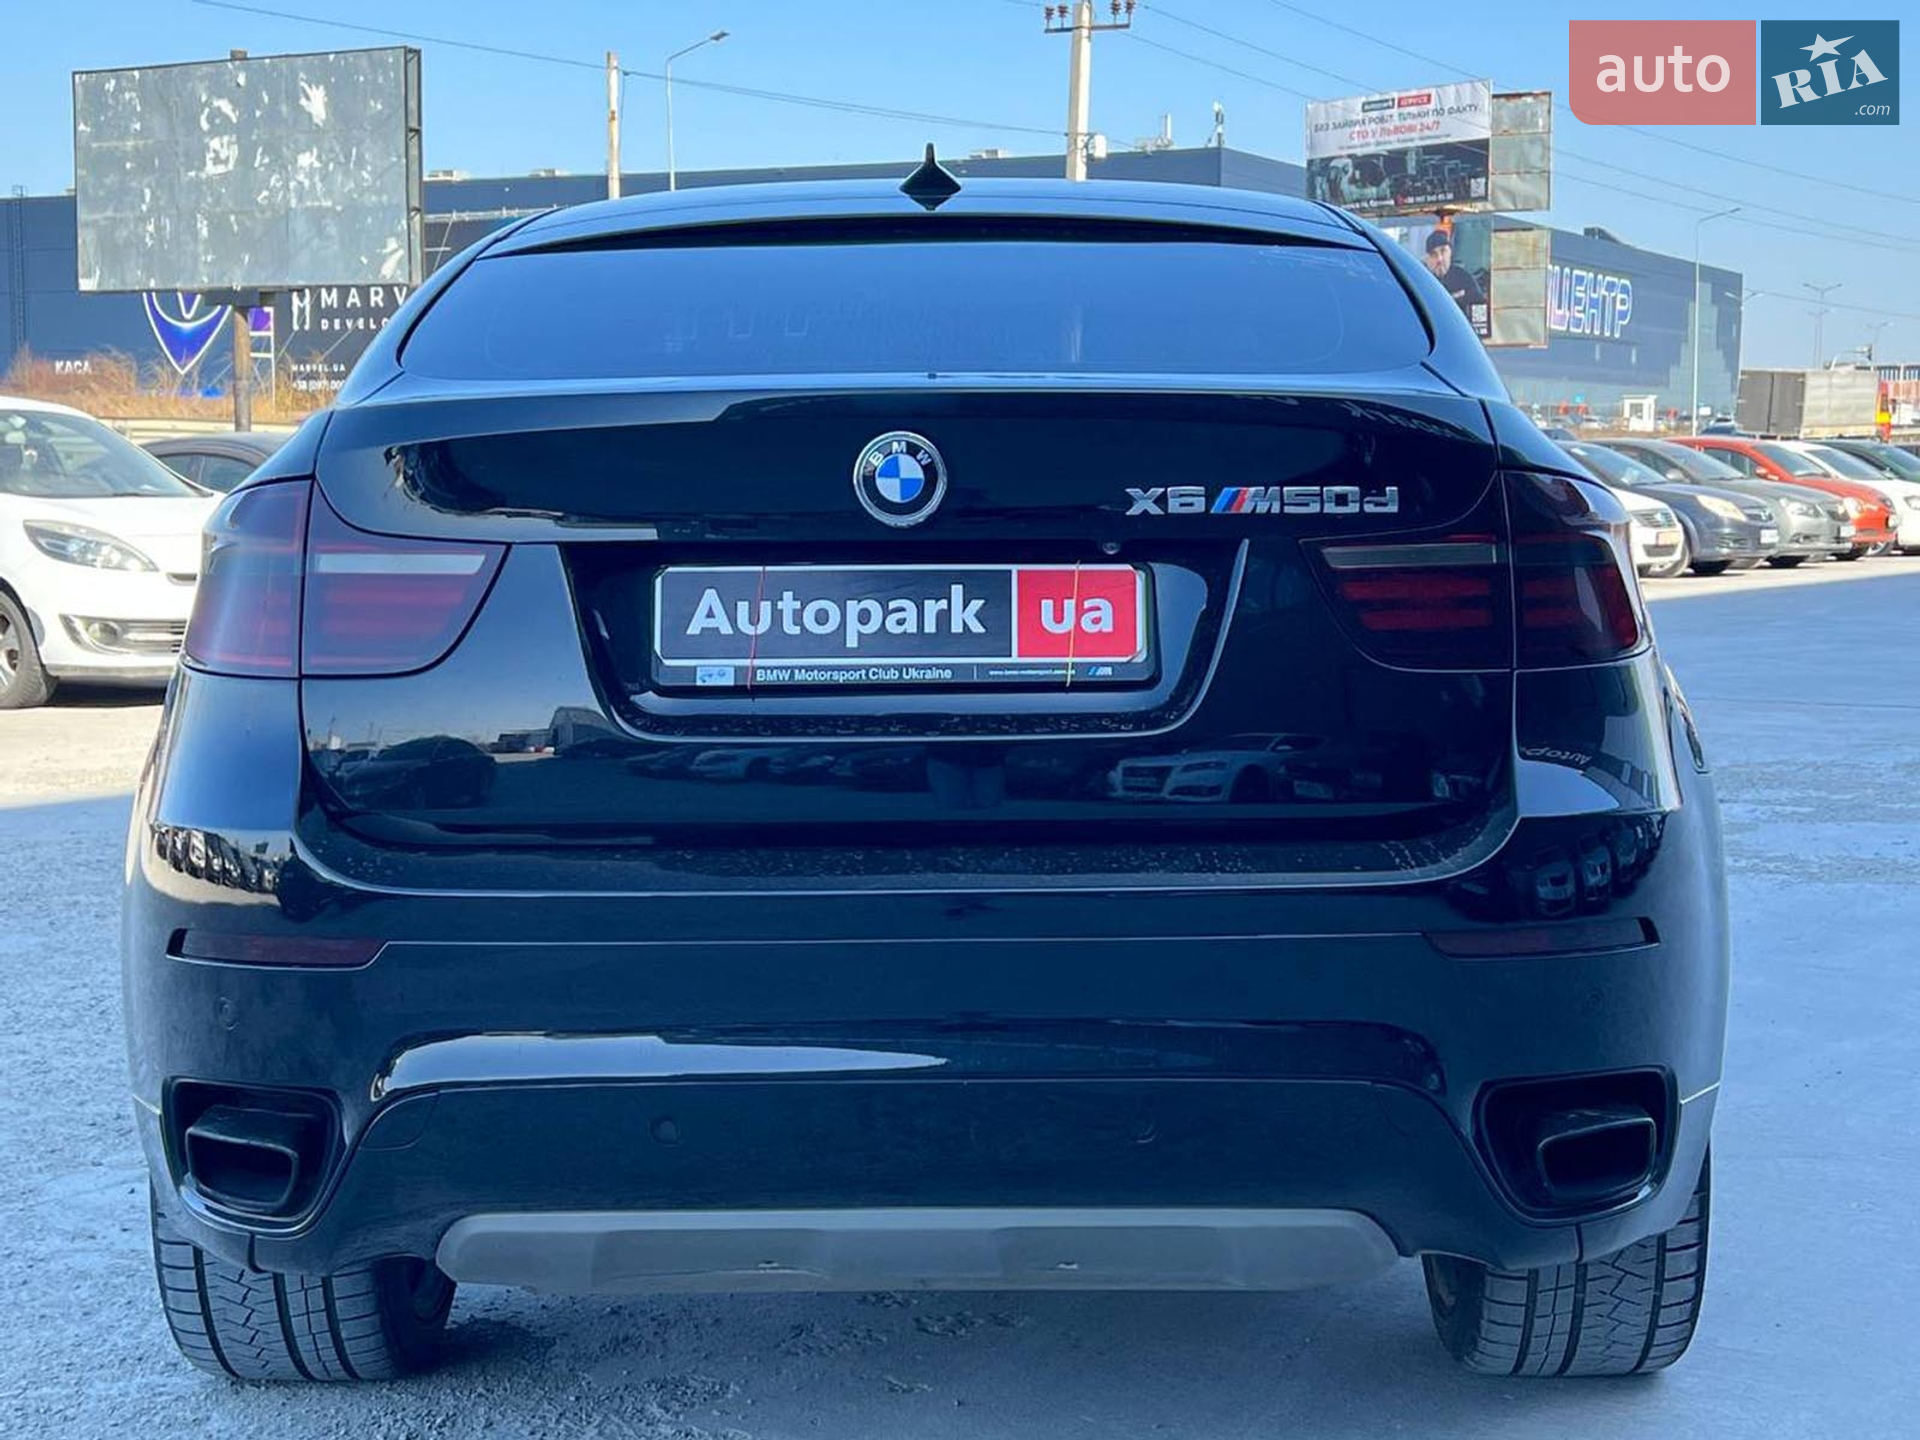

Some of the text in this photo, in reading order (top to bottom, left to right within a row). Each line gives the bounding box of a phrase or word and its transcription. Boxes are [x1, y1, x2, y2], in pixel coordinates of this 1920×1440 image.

[1432, 107, 1445, 117] ПО
[1348, 129, 1369, 141] СТО
[54, 360, 92, 375] КАСА
[868, 441, 932, 467] BMW
[1125, 486, 1206, 515] X6
[686, 584, 1114, 648] Autopark ua
[756, 667, 952, 682] BMW Motorsport Club Ukraine
